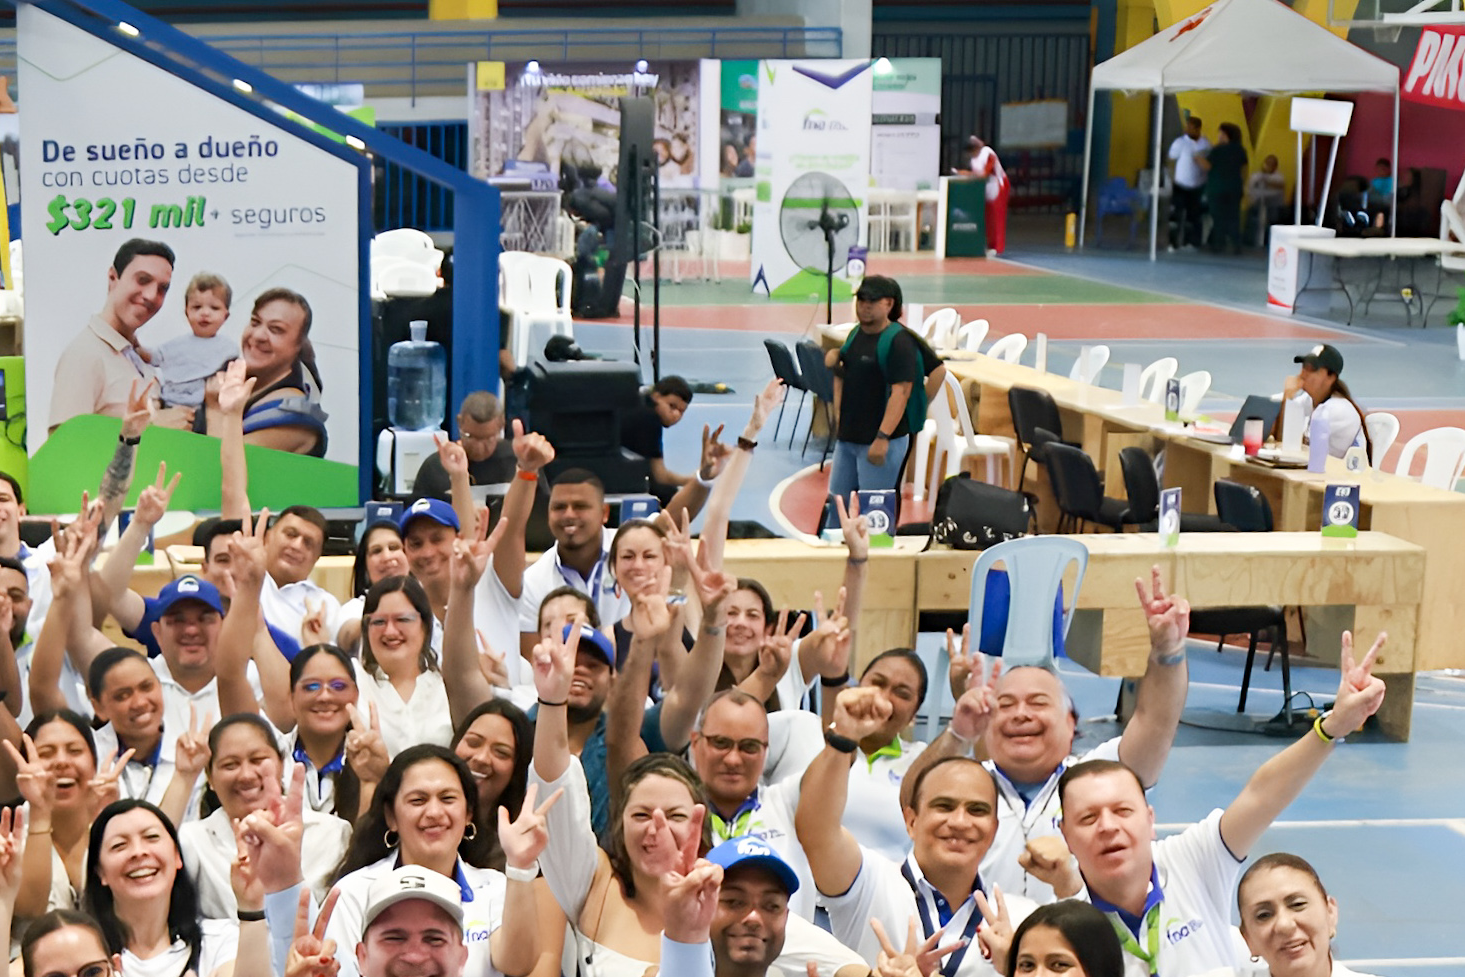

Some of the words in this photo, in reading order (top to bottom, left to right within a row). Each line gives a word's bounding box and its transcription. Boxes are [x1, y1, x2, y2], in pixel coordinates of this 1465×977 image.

[42, 139, 75, 162] De
[87, 137, 165, 161] sueño
[175, 140, 188, 158] a
[198, 135, 279, 158] dueño
[42, 169, 83, 187] con
[92, 166, 169, 186] cuotas
[178, 163, 249, 185] desde
[45, 194, 136, 236] $321
[148, 195, 207, 229] mil
[231, 205, 326, 229] seguros
